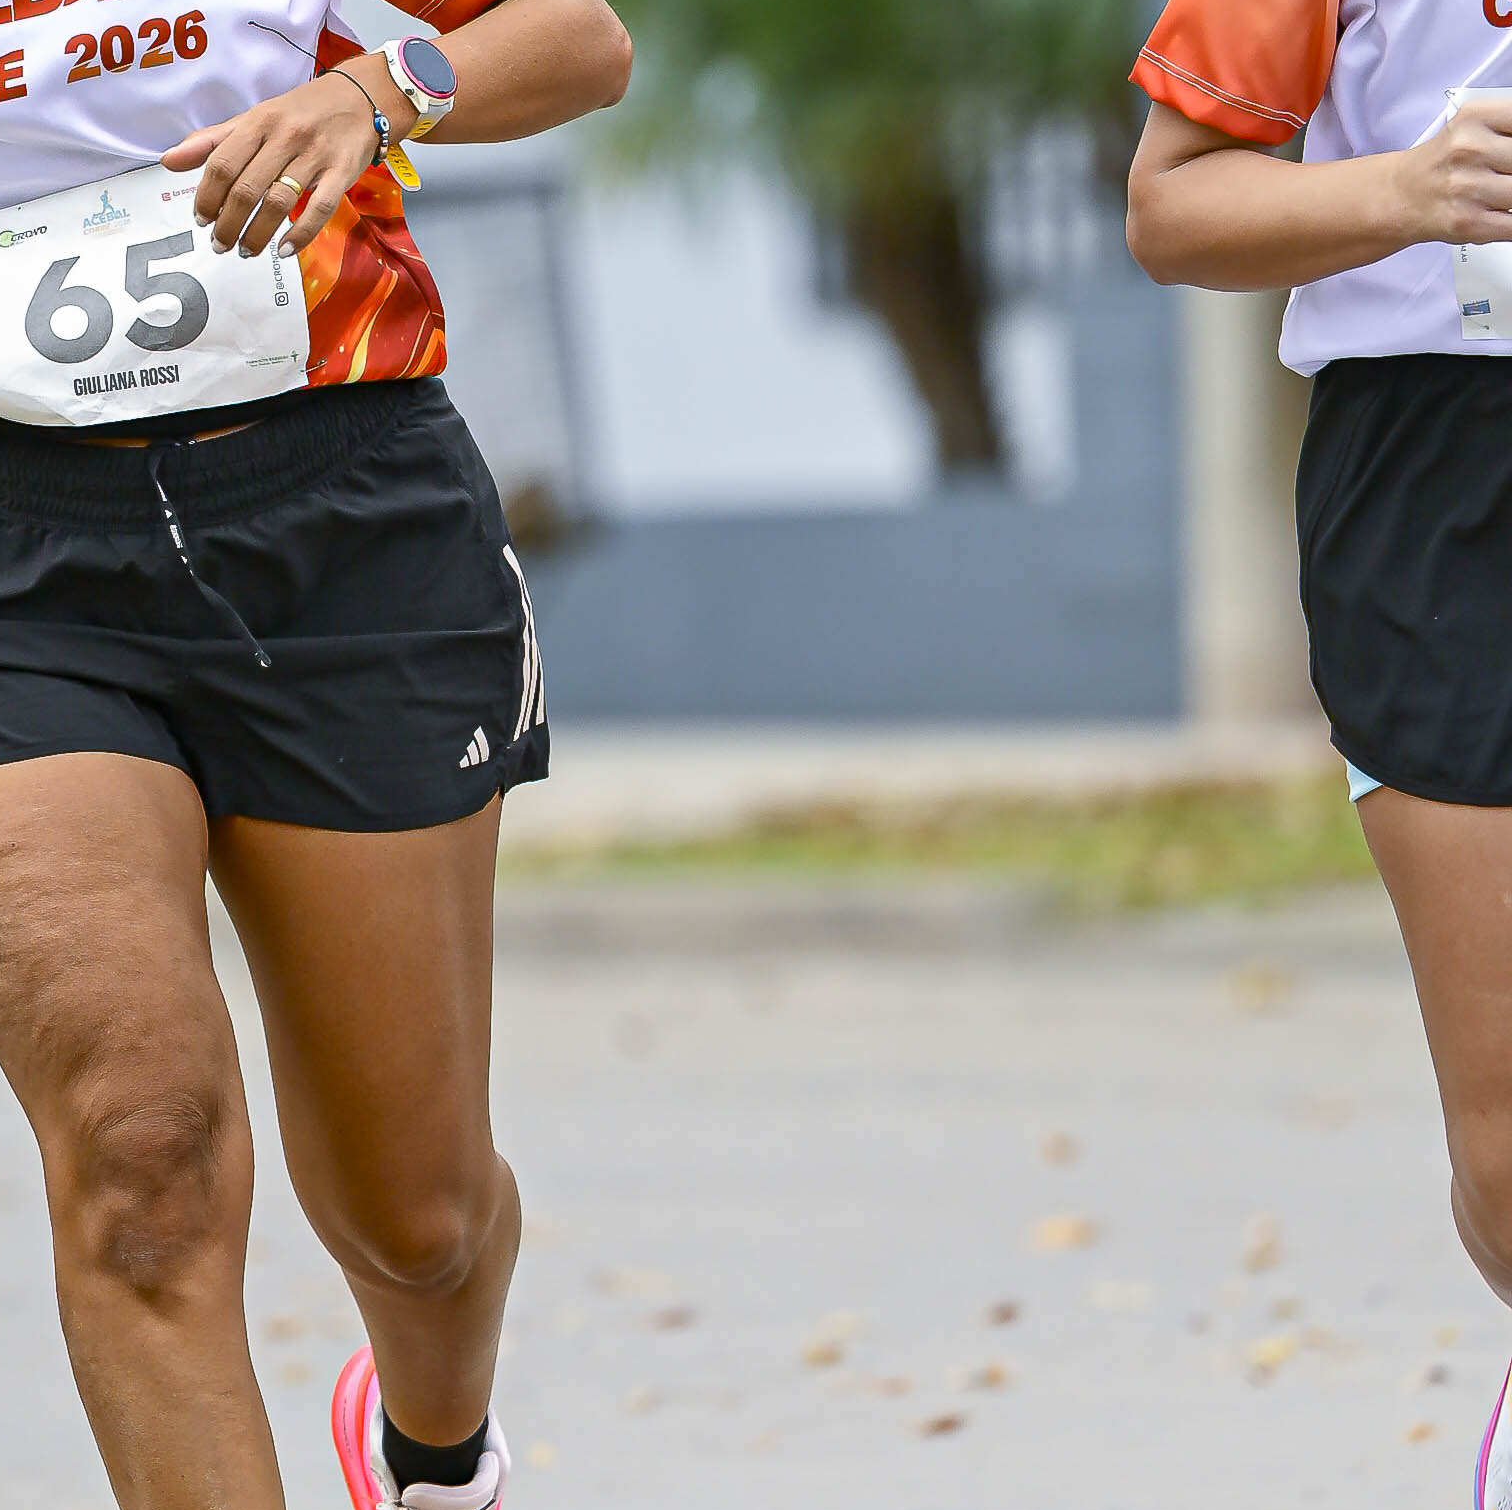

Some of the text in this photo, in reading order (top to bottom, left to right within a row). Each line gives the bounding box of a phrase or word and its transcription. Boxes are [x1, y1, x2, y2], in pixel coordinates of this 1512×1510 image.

[64, 10, 208, 84] 2026
[83, 208, 131, 228] ACEBAL
[25, 229, 209, 364] 65
[73, 365, 180, 396] GIULIANA ROSSI
